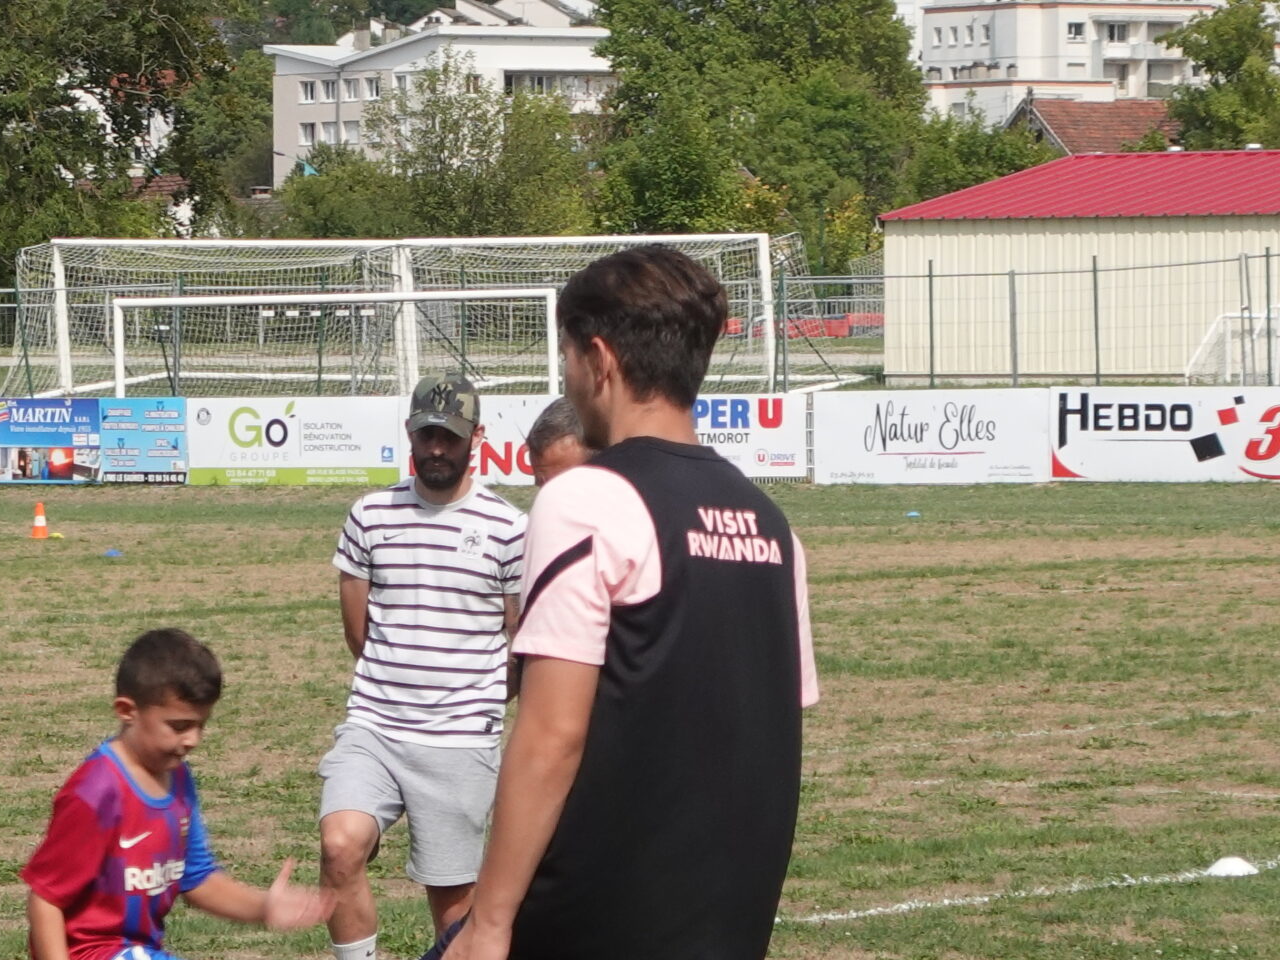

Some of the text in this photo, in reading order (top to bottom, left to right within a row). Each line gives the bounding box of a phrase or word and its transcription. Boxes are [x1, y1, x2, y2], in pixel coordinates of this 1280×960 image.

[10, 407, 72, 423] MARTIN
[758, 398, 783, 429] U
[1059, 392, 1193, 450] HEBDO
[304, 432, 352, 441] RÉNOVATION
[304, 444, 361, 452] CONSTRUCTION
[230, 452, 289, 461] GROUPE
[770, 453, 796, 461] DRIVE
[698, 507, 758, 535] VISIT
[687, 530, 783, 565] RWANDA
